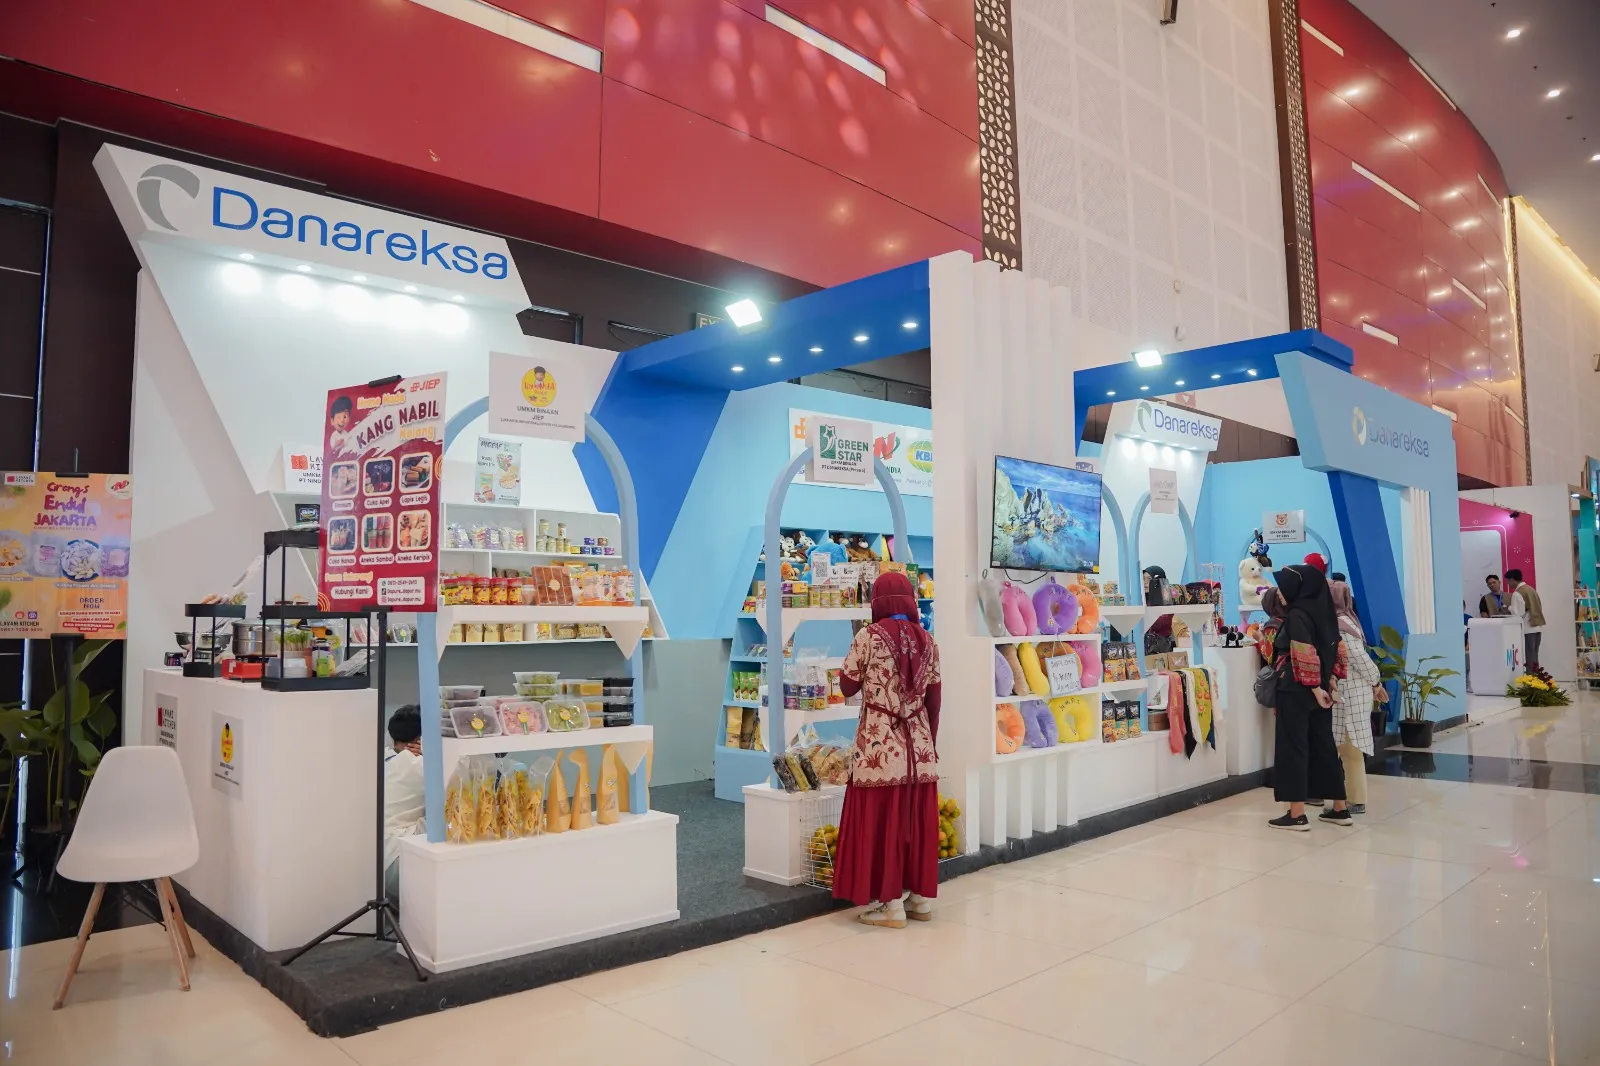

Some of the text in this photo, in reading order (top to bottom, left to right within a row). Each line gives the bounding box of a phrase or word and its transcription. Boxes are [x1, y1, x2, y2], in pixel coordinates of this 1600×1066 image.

[213, 186, 508, 279] Danareksa
[420, 378, 440, 392] JIEP
[356, 400, 439, 449] KANG NABIL
[1154, 408, 1219, 442] Danareksa
[837, 439, 869, 452] GREEN
[838, 451, 863, 462] STAR
[401, 495, 428, 504] Lapis Legit
[34, 513, 97, 527] JAKARTA
[376, 555, 394, 563] Sambal
[413, 553, 430, 562] Keripik
[335, 588, 354, 597] Hubungi
